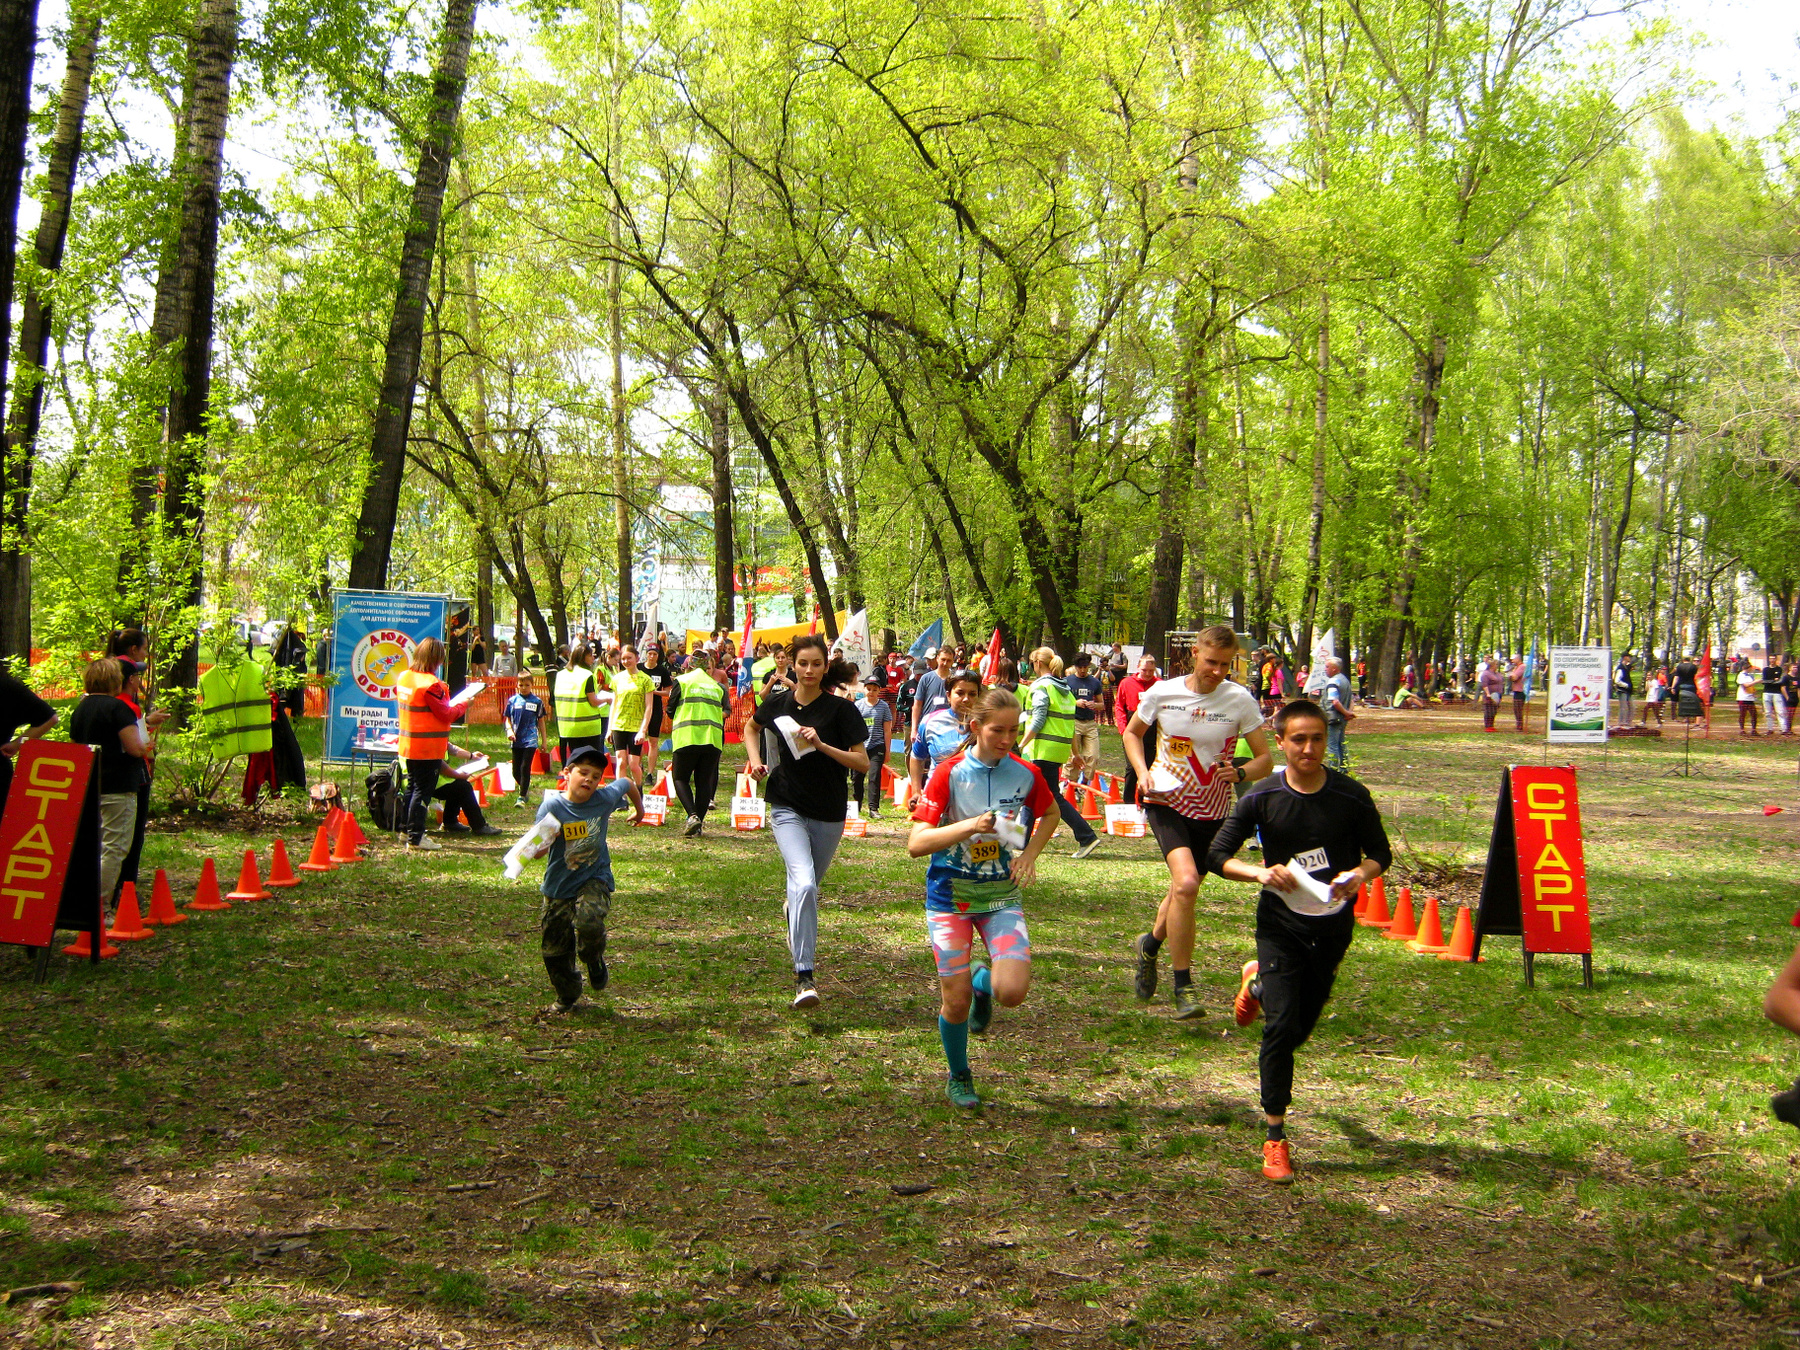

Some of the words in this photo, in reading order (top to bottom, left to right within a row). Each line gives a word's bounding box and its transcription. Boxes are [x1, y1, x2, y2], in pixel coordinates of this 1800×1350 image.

[369, 632, 409, 648] ДЮЦ
[345, 707, 359, 716] Мы
[1171, 742, 1190, 753] 457
[1, 757, 76, 920] СТАРТ
[566, 825, 586, 838] 310
[973, 845, 997, 859] 389
[1527, 783, 1575, 932] СТАРТ
[1298, 852, 1326, 869] 920
